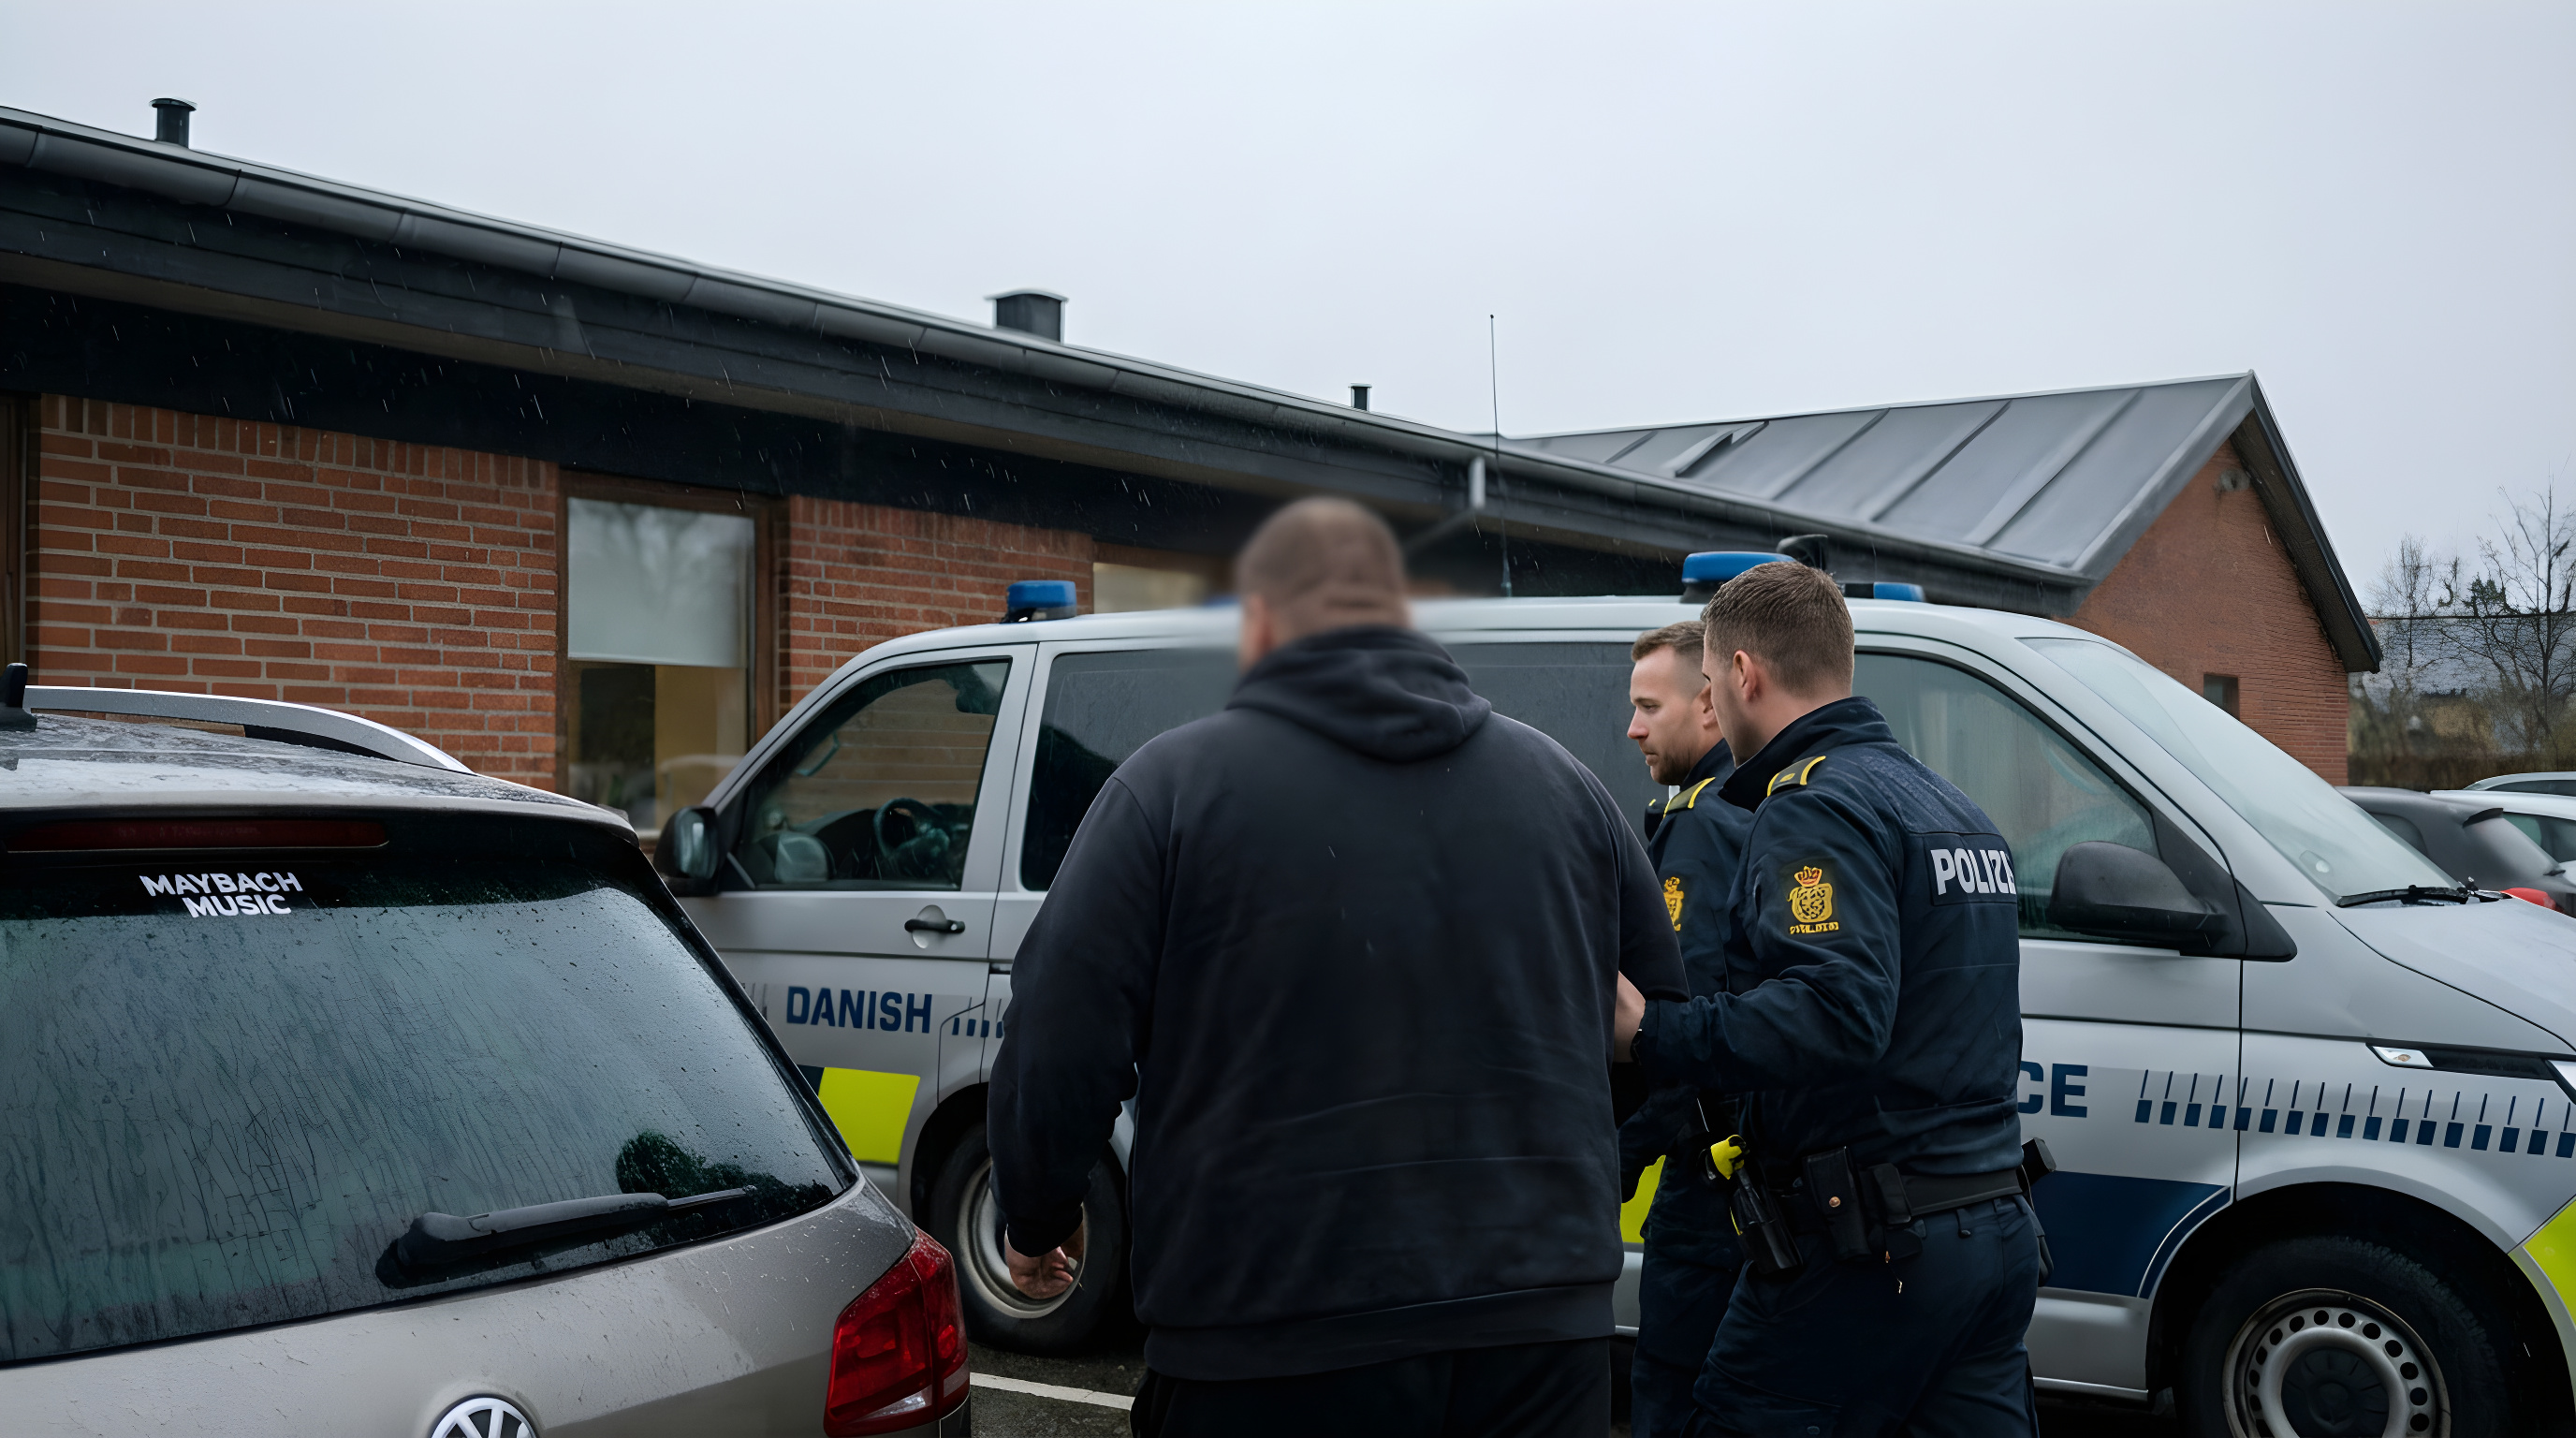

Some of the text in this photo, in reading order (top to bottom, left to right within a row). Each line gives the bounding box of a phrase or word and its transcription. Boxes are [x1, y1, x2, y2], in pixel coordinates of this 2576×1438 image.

[139, 872, 303, 896] MAYBACH
[182, 894, 291, 917] MUSIC
[786, 986, 932, 1034] DANISH
